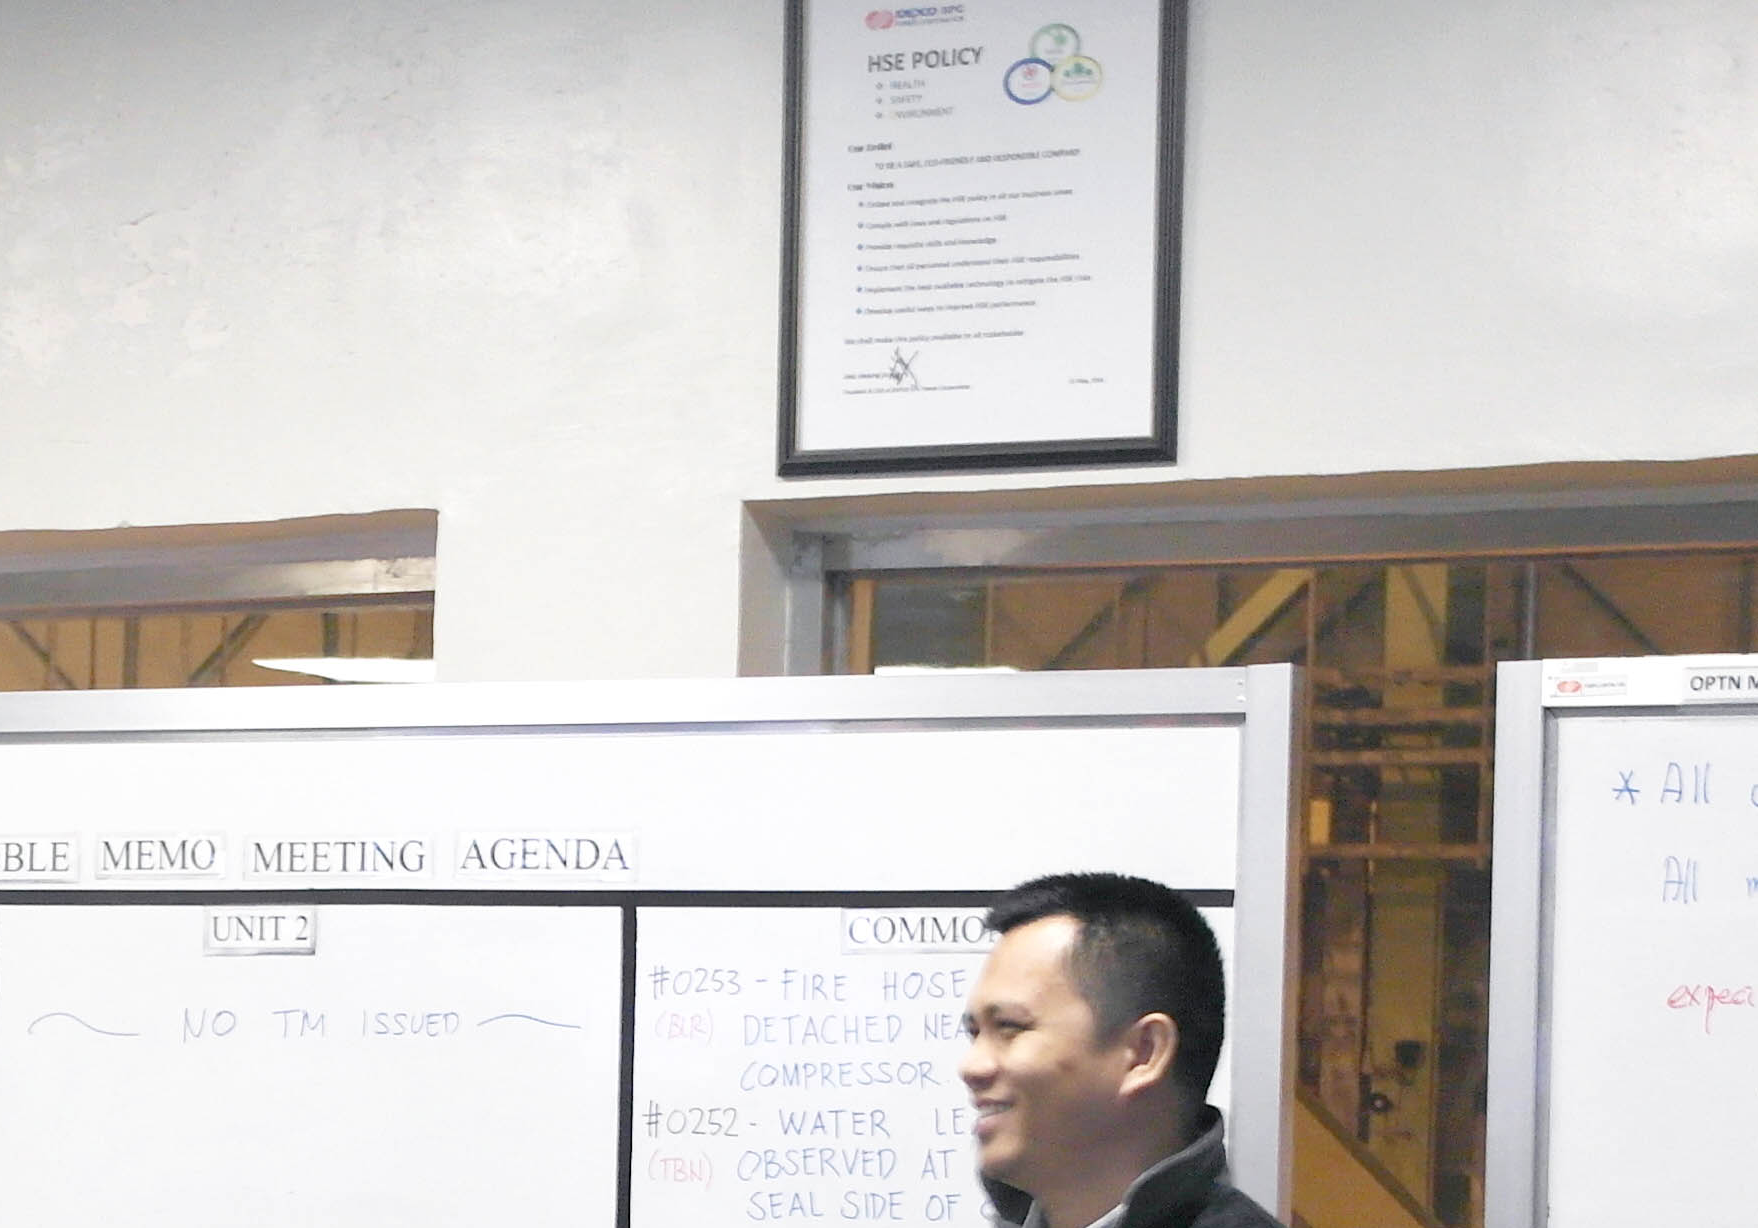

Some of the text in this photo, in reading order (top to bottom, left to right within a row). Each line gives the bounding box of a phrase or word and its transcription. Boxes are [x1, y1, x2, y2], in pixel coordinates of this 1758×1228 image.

[868, 47, 983, 72] HSE POLICY
[1690, 676, 1741, 691] OPTN
[101, 840, 215, 871] MEMO
[252, 839, 426, 874] MEETING
[459, 837, 631, 871] AGENDA
[212, 915, 309, 943] UNIT 2
[849, 916, 995, 944] COMMO
[781, 969, 848, 1002] FIRE
[884, 969, 966, 1000] HOSE
[183, 1009, 460, 1041] NO TM ISSUED
[743, 1013, 902, 1046] DETACHED
[923, 1013, 970, 1041] NEA
[779, 1108, 891, 1138] WATER
[737, 1149, 896, 1182] OBSERVED
[922, 1149, 957, 1179] AT
[747, 1191, 823, 1221] SEAL
[841, 1191, 903, 1220] SIDE
[925, 1194, 961, 1221] OF
